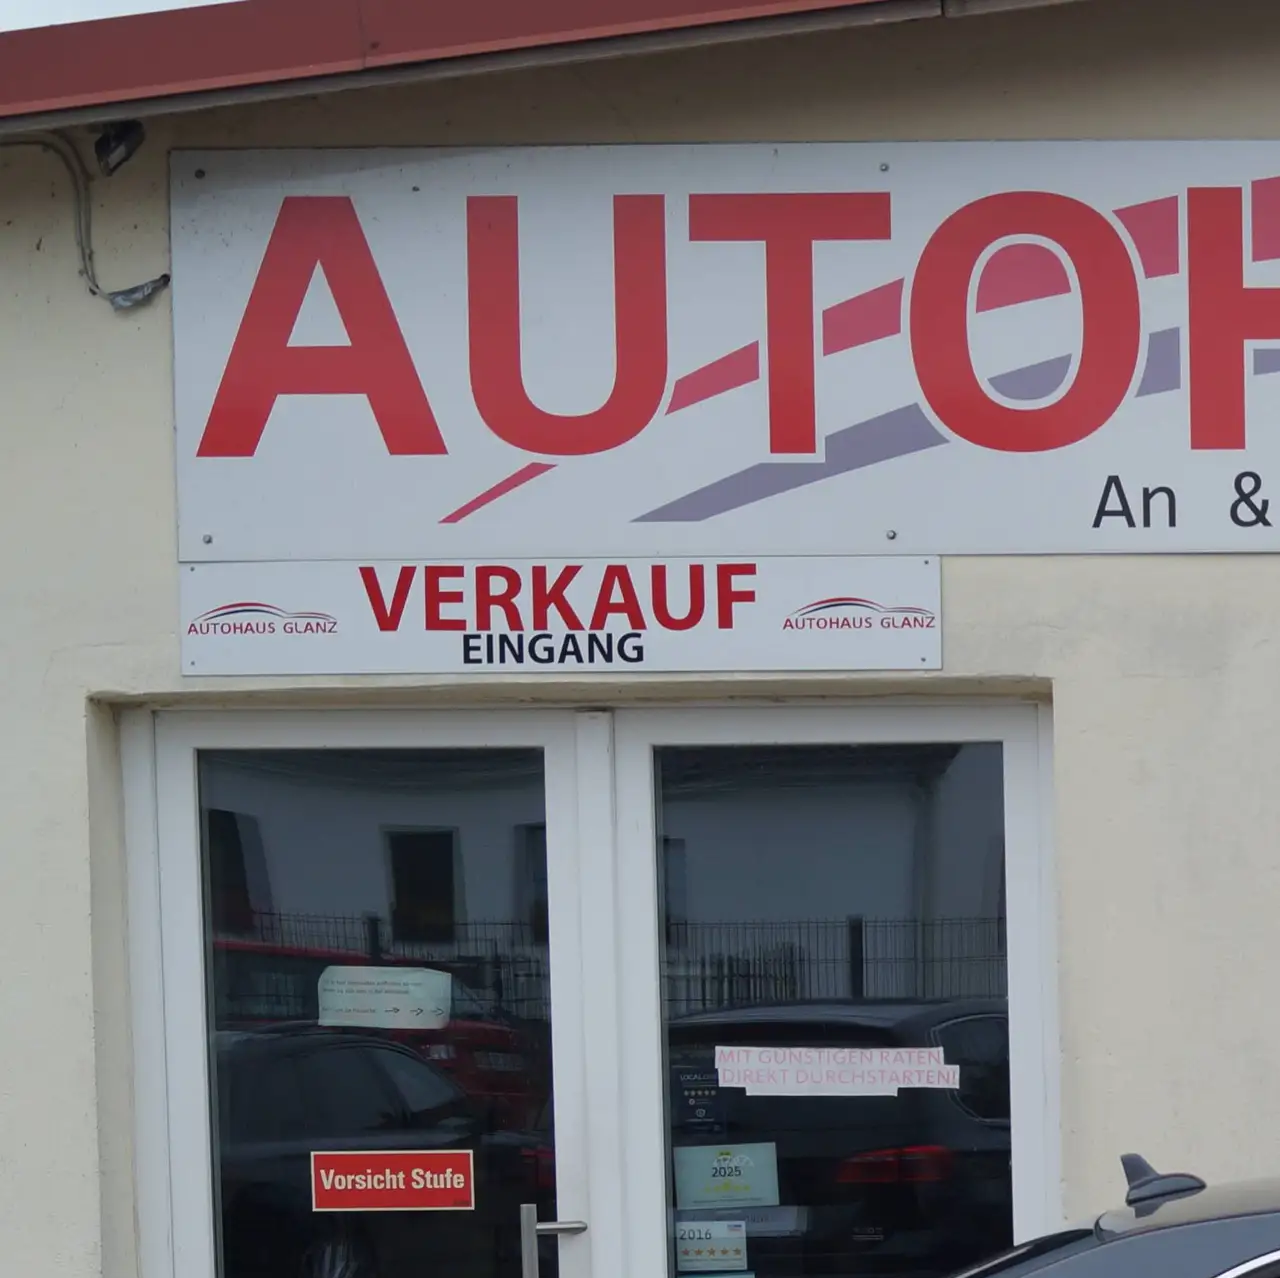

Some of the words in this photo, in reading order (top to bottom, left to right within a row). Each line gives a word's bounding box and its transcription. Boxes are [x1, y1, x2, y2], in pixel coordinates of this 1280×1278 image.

[1092, 475, 1176, 529] An
[1229, 471, 1274, 529] &
[359, 563, 757, 632] VERKAUF
[187, 621, 276, 635] AUTOHAUS
[282, 621, 338, 634] GLANZ
[782, 616, 873, 630] AUTOHAUS
[880, 616, 936, 629] GLANZ
[463, 633, 645, 664] EINGANG
[718, 1049, 752, 1064] MIT
[880, 1049, 941, 1064] RATEN
[722, 1068, 789, 1085] DIREKT
[796, 1068, 958, 1086] DURCHSTARTEN!
[320, 1169, 406, 1190] Vorsicht
[411, 1168, 465, 1189] Stufe
[711, 1166, 742, 1178] 2025
[679, 1229, 712, 1241] 2016
